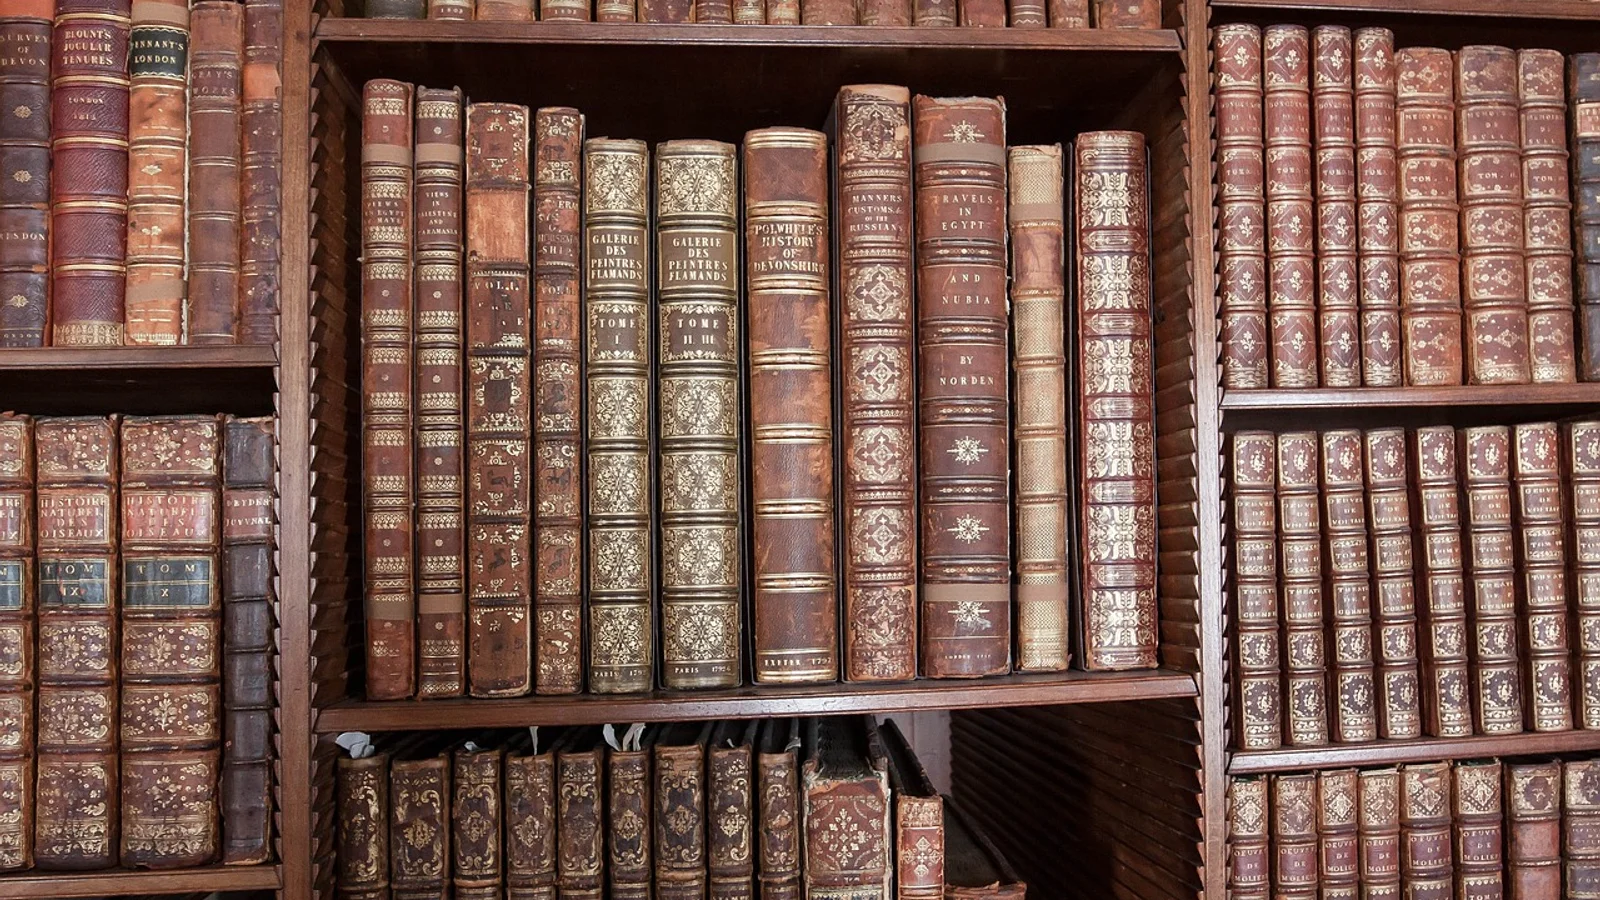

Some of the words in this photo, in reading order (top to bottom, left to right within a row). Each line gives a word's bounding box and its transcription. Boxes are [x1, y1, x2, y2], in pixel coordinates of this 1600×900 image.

[64, 29, 112, 40] BLOUNT'S
[17, 46, 29, 54] OF
[63, 43, 112, 52] JOCULAR
[1, 58, 46, 66] DEVON
[62, 55, 114, 66] TENURES
[134, 55, 176, 64] LONDON
[852, 194, 903, 203] MANNERS
[930, 194, 993, 204] TRAVELS
[960, 206, 972, 217] IN
[754, 223, 824, 237] POLWHELE'S
[942, 220, 985, 231] EGYPT
[592, 234, 640, 245] GALERIE
[672, 237, 722, 247] GALERIE
[762, 235, 815, 248] HISTORY
[606, 245, 627, 256] DES
[688, 248, 710, 258] DES
[783, 248, 804, 259] OF
[591, 258, 643, 270] PEINTRES
[668, 260, 728, 271] PEINTRES
[754, 260, 826, 273] DEVONSHIRE
[591, 269, 643, 280] FLAMANDS
[668, 270, 727, 281] FLAMANDS
[950, 274, 982, 284] AND
[942, 295, 991, 306] NUBIA
[600, 318, 637, 329] TOME
[677, 318, 720, 329] TOME
[960, 356, 974, 365] BY
[939, 377, 995, 386] NORDEN
[41, 498, 105, 508] HISTOIRE
[57, 518, 89, 527] DES
[41, 529, 104, 538] OISEAUX
[126, 528, 209, 538] OISEAUX
[44, 563, 94, 575] TOM
[136, 564, 196, 575] TOM
[62, 586, 80, 596] IX
[160, 588, 169, 597] X
[674, 666, 700, 674] PARIS
